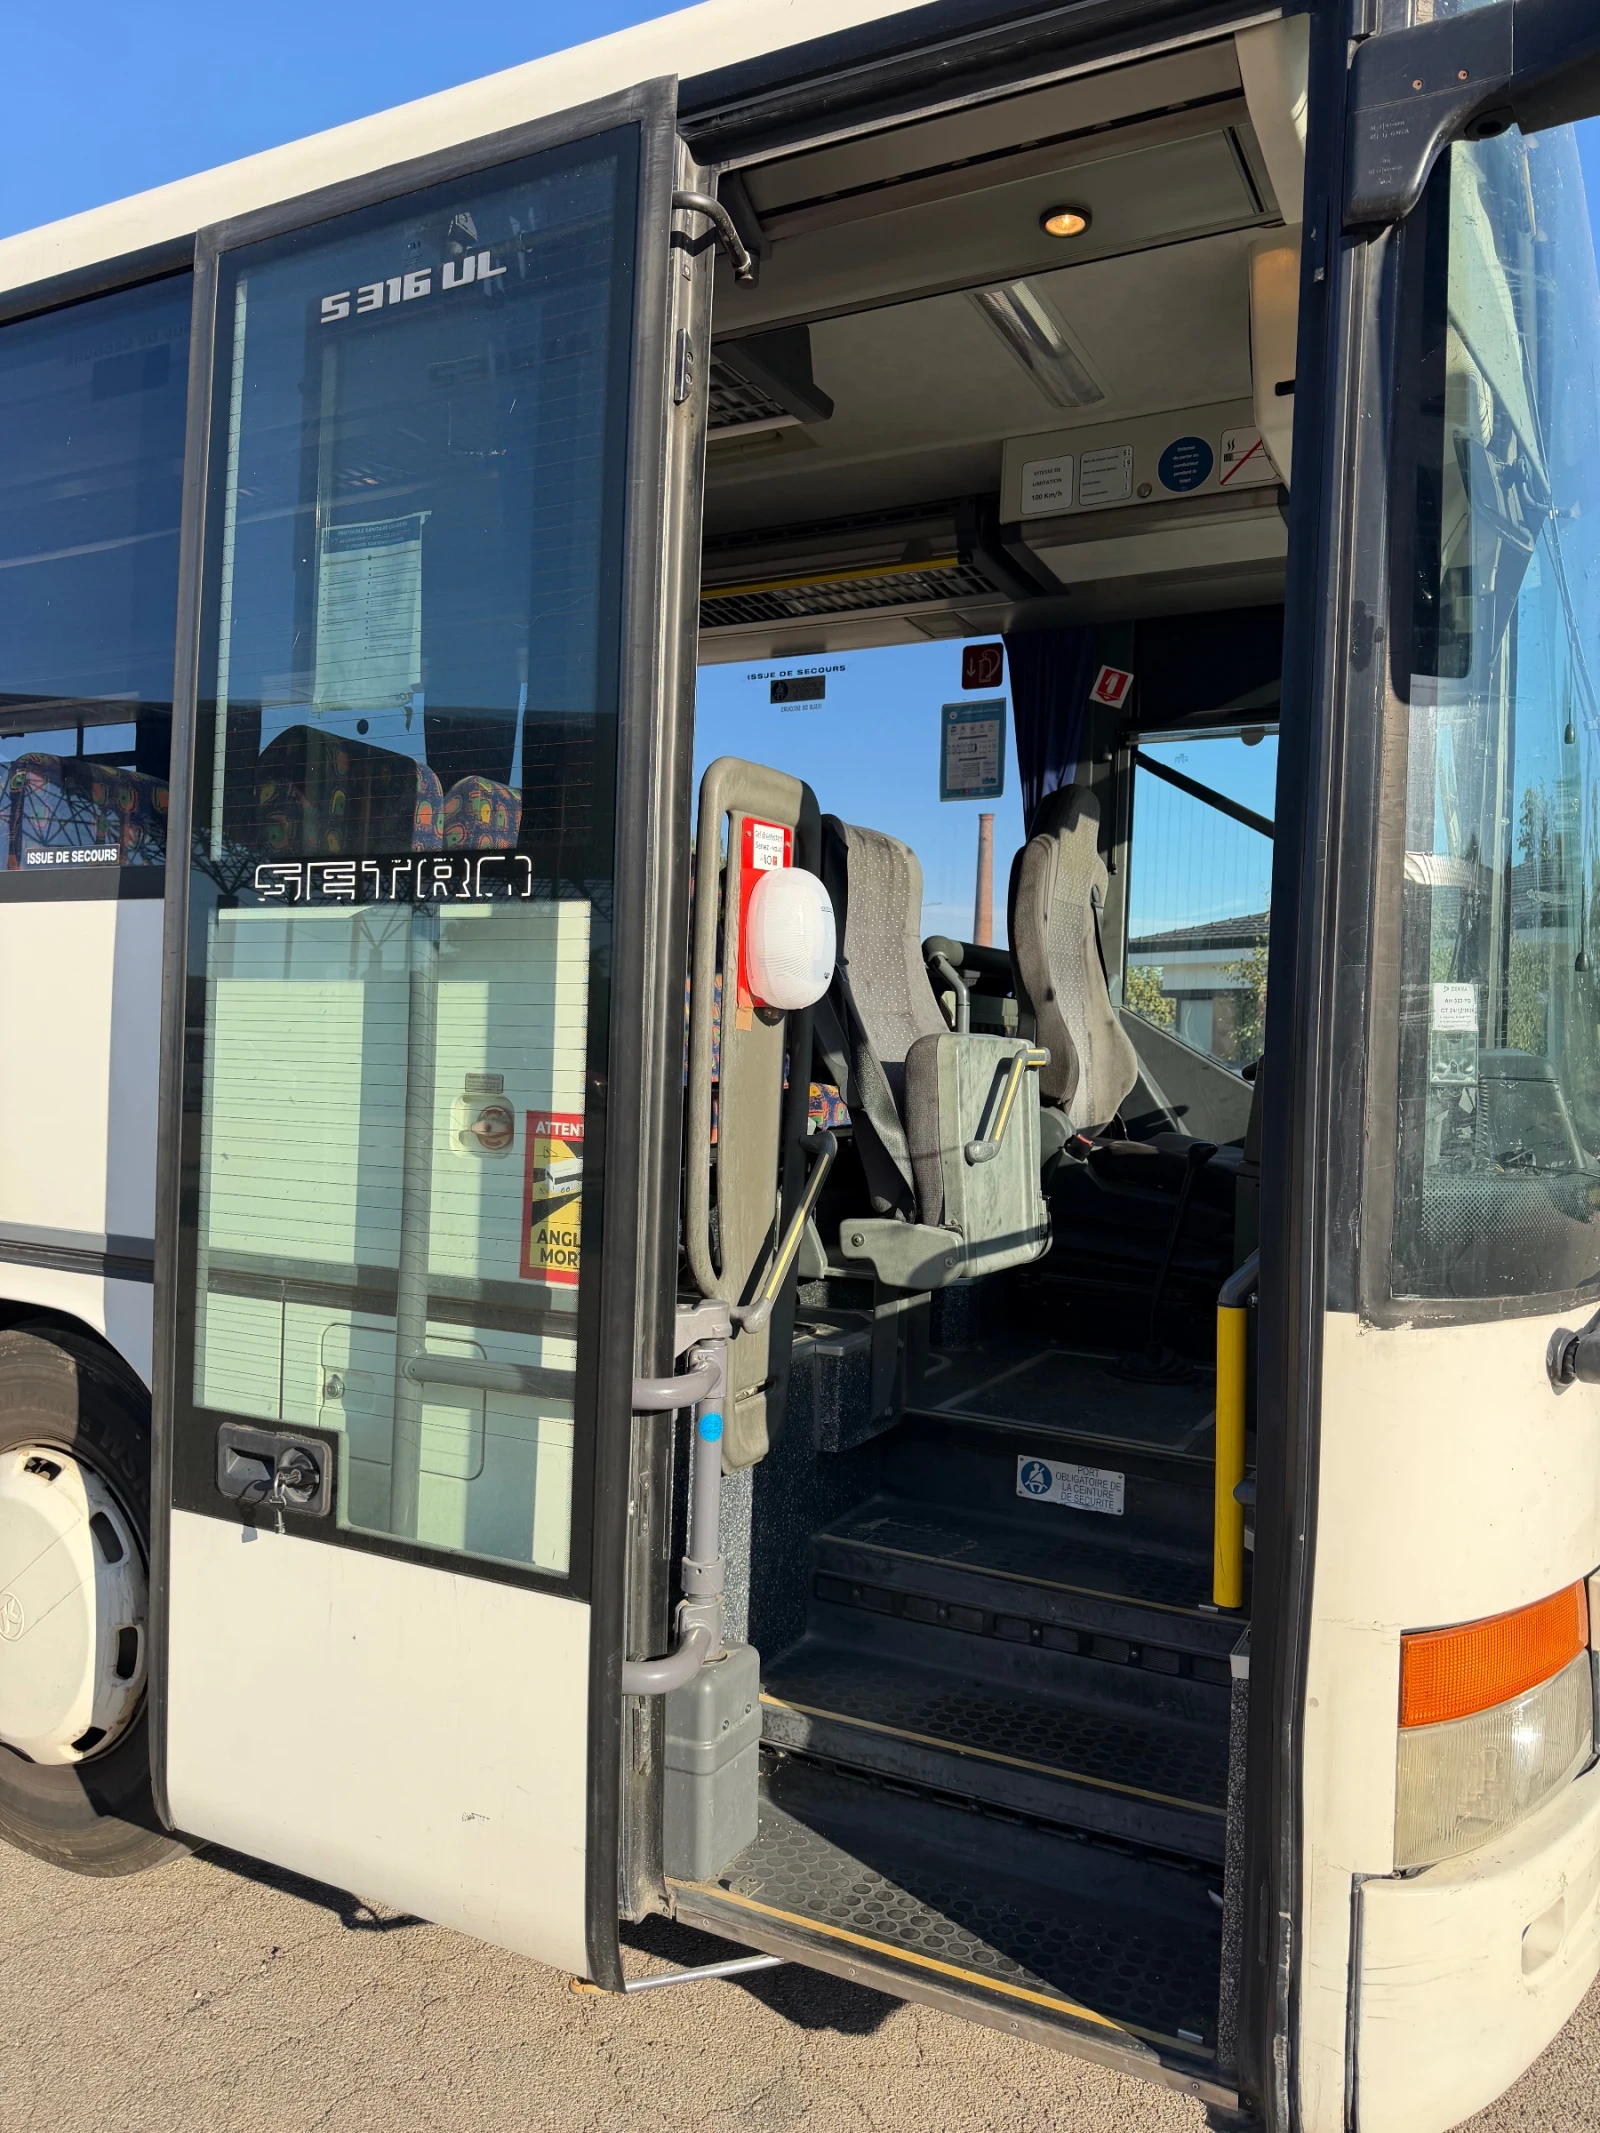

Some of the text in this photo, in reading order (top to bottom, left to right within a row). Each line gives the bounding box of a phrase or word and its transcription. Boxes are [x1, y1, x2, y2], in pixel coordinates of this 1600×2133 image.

[321, 291, 350, 324] S
[357, 268, 432, 314] 316
[442, 251, 507, 290] UL
[747, 672, 776, 681] ISSUE
[796, 665, 846, 676] SECOURS
[27, 848, 117, 865] ISSUE DE SECOURS
[1077, 1466, 1099, 1478] PORT
[1055, 1472, 1122, 1492] OBLIGATOIRE DE
[1062, 1482, 1114, 1500] LA CEINTURE
[1060, 1491, 1072, 1502] DE
[1074, 1493, 1114, 1510] SECURITE
